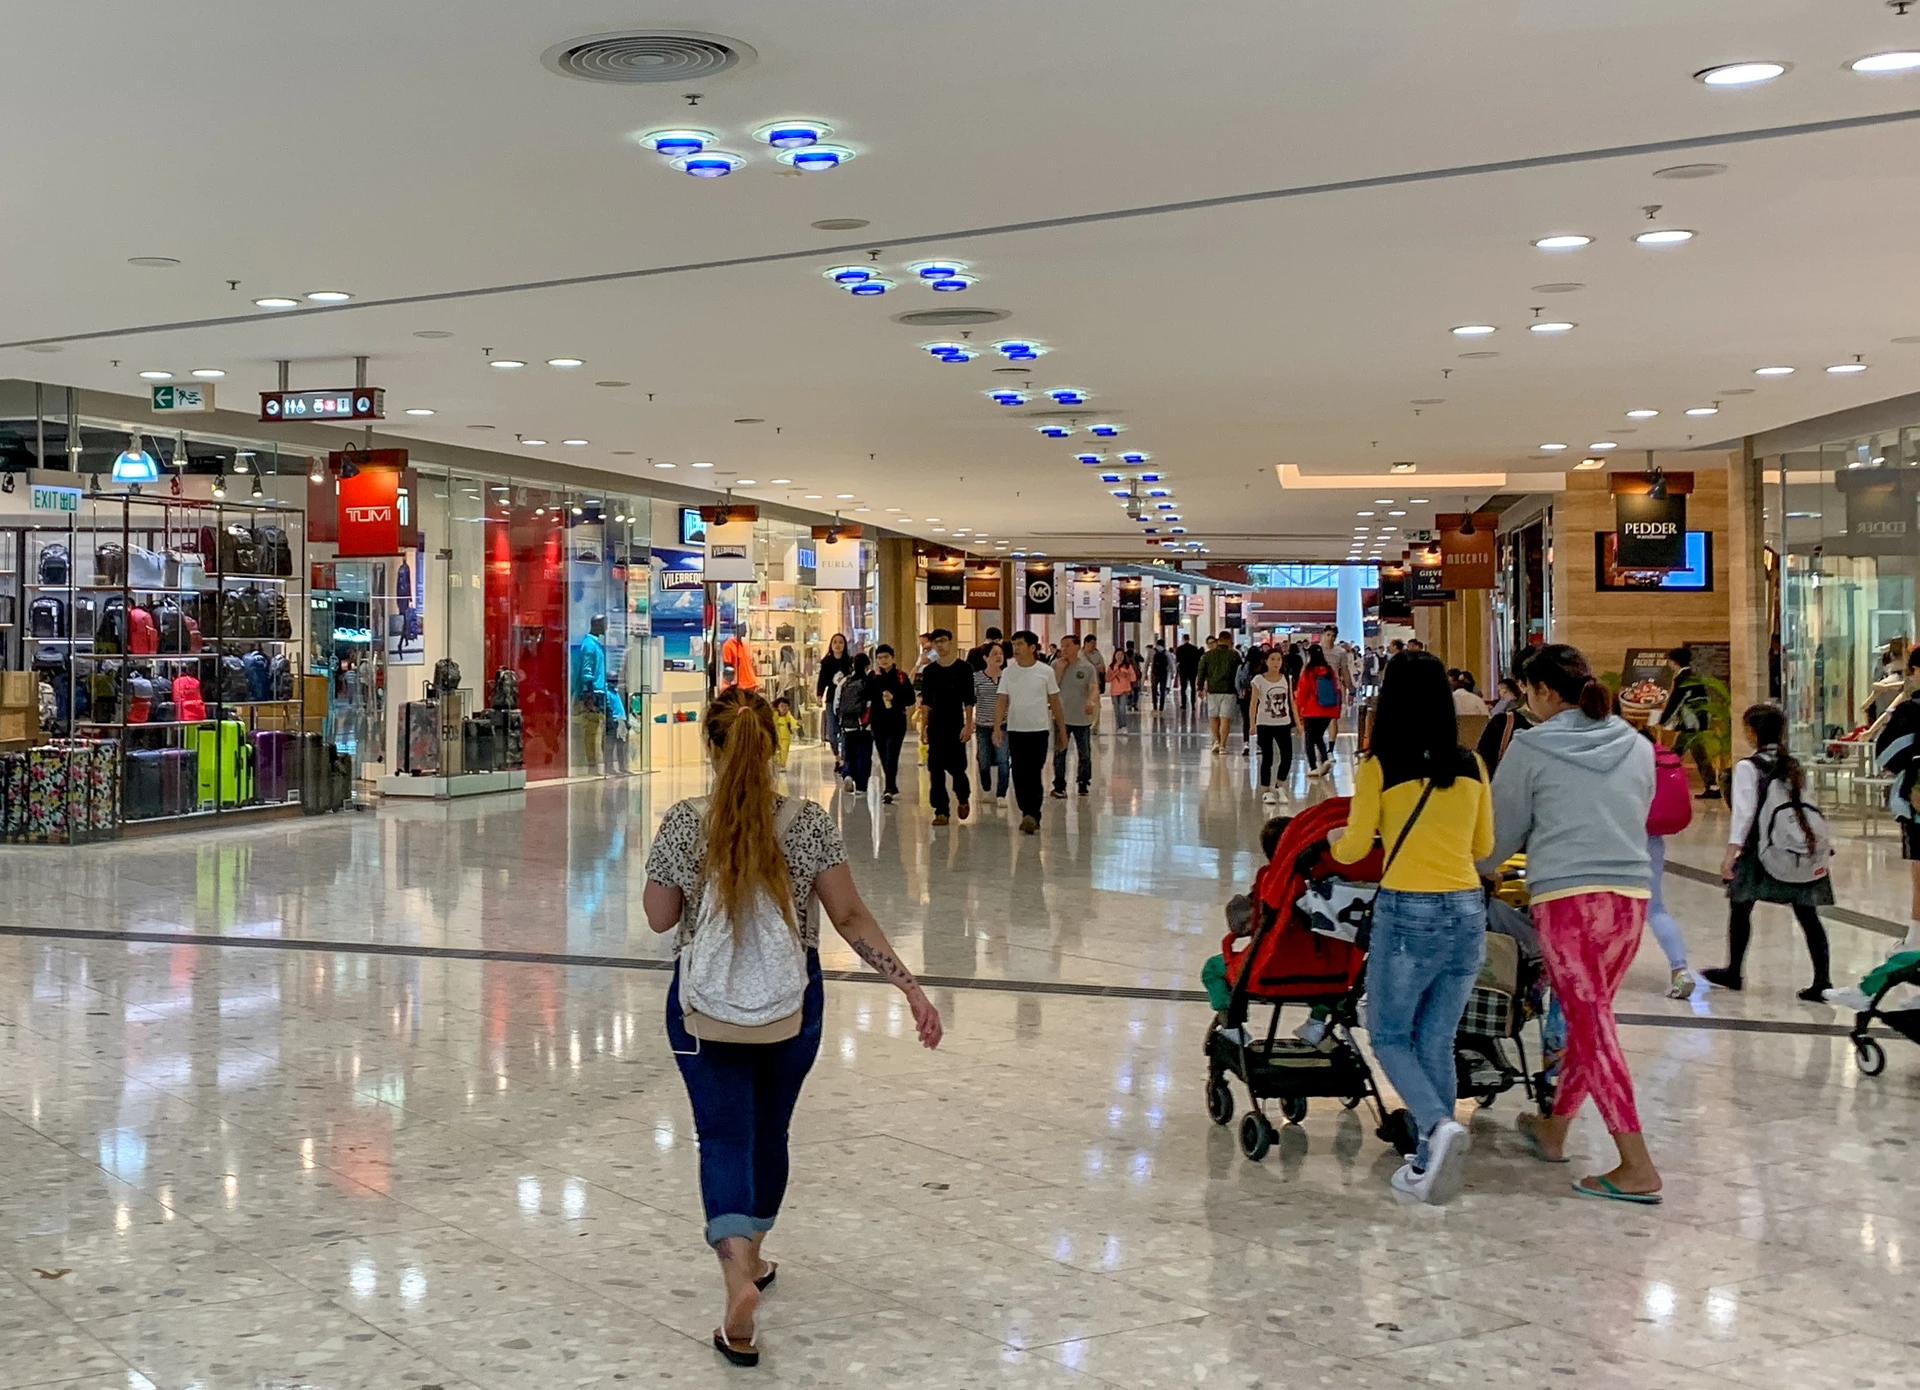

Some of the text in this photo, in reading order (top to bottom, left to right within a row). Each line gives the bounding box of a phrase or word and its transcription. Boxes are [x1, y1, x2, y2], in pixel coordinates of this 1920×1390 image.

[34, 489, 77, 511] EXIT 出口
[345, 506, 391, 522] TUMI
[1624, 522, 1678, 534] PEDDER
[712, 546, 746, 557] VILEBREQUIN
[821, 560, 854, 568] FURLA
[1031, 586, 1049, 597] MK
